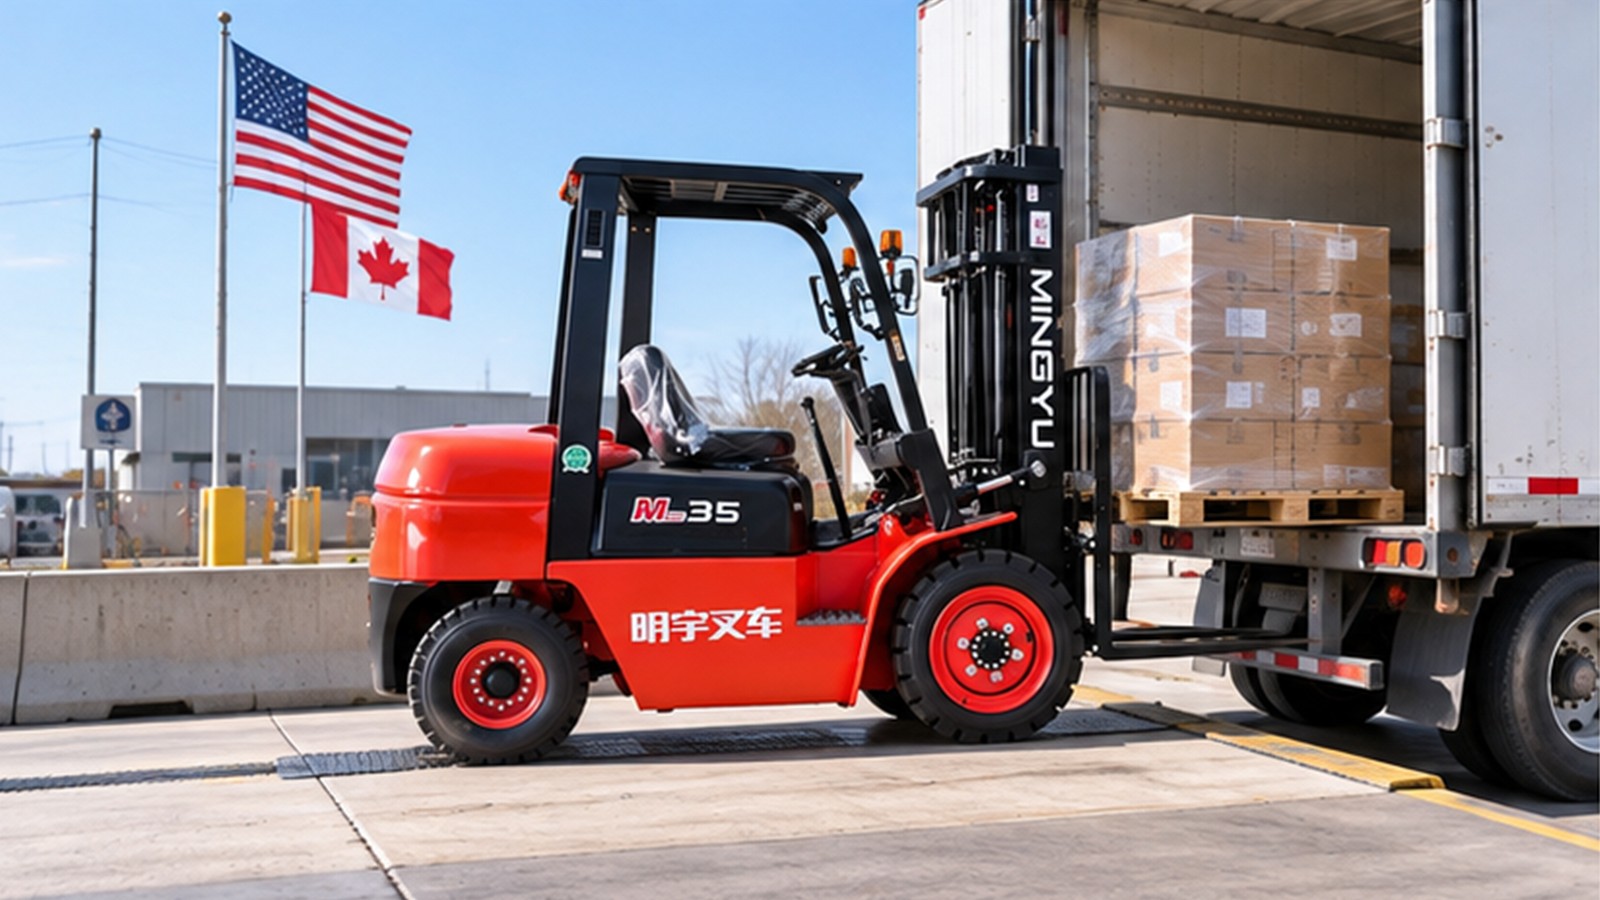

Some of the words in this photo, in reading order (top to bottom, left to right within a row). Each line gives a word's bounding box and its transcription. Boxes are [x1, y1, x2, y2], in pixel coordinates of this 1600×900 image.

[1029, 268, 1055, 449] MINGYU
[630, 606, 783, 643] 明宇叉车
